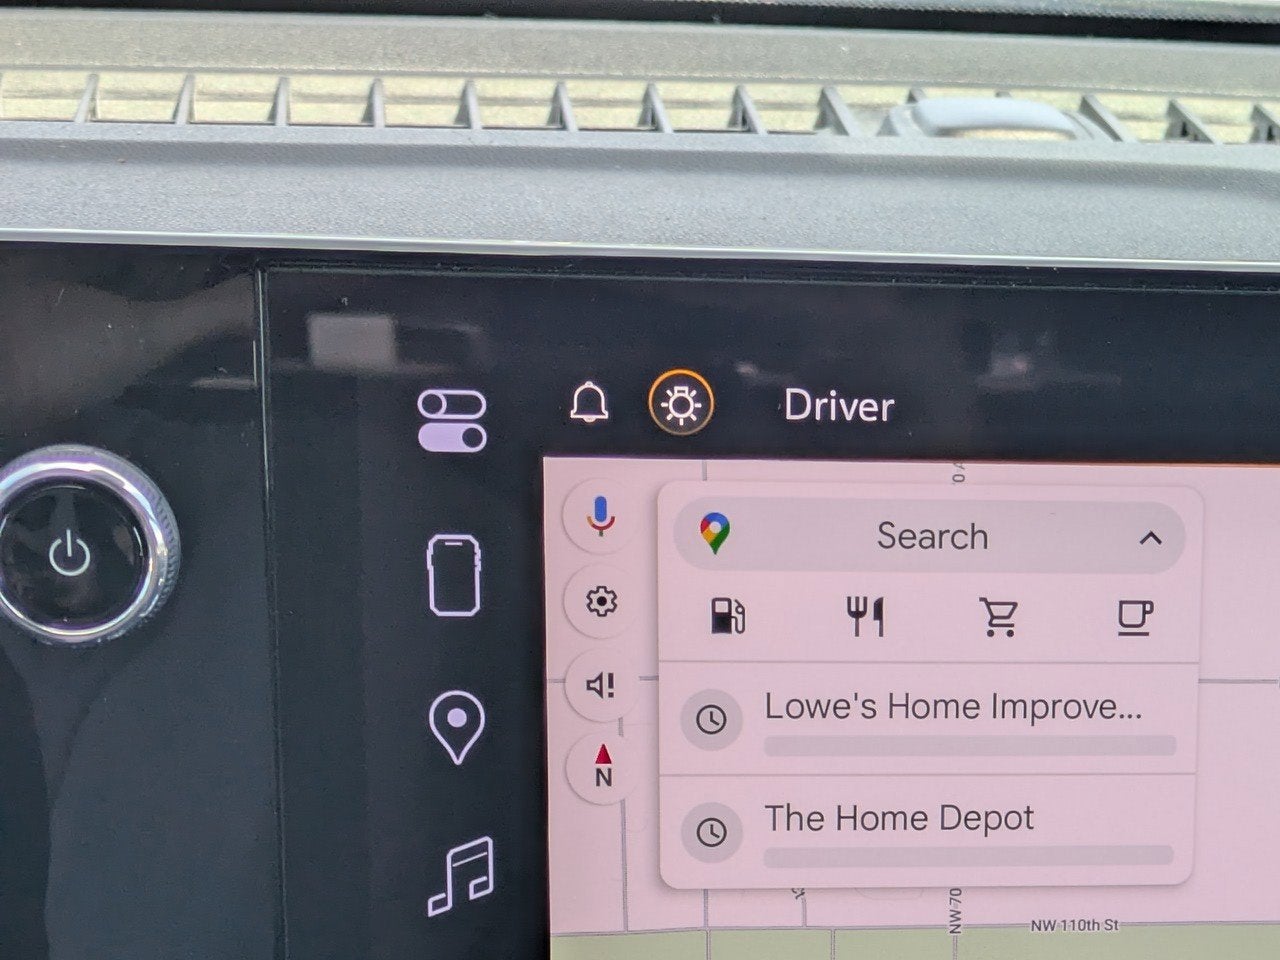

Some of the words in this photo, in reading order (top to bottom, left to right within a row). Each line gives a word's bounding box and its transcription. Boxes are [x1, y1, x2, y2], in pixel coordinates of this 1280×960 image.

[785, 389, 894, 422] Driver
[877, 522, 989, 551] Search
[766, 692, 877, 720] Lowe's
[889, 692, 980, 720] Home
[992, 692, 1142, 726] Improve...
[596, 768, 612, 787] N
[765, 802, 824, 831] The
[837, 804, 928, 831] Home
[941, 804, 1034, 837] Depot
[950, 888, 962, 905] 70
[950, 909, 962, 935] NW
[1031, 919, 1056, 931] NW
[1060, 919, 1100, 931] 110th
[1104, 919, 1119, 931] St
